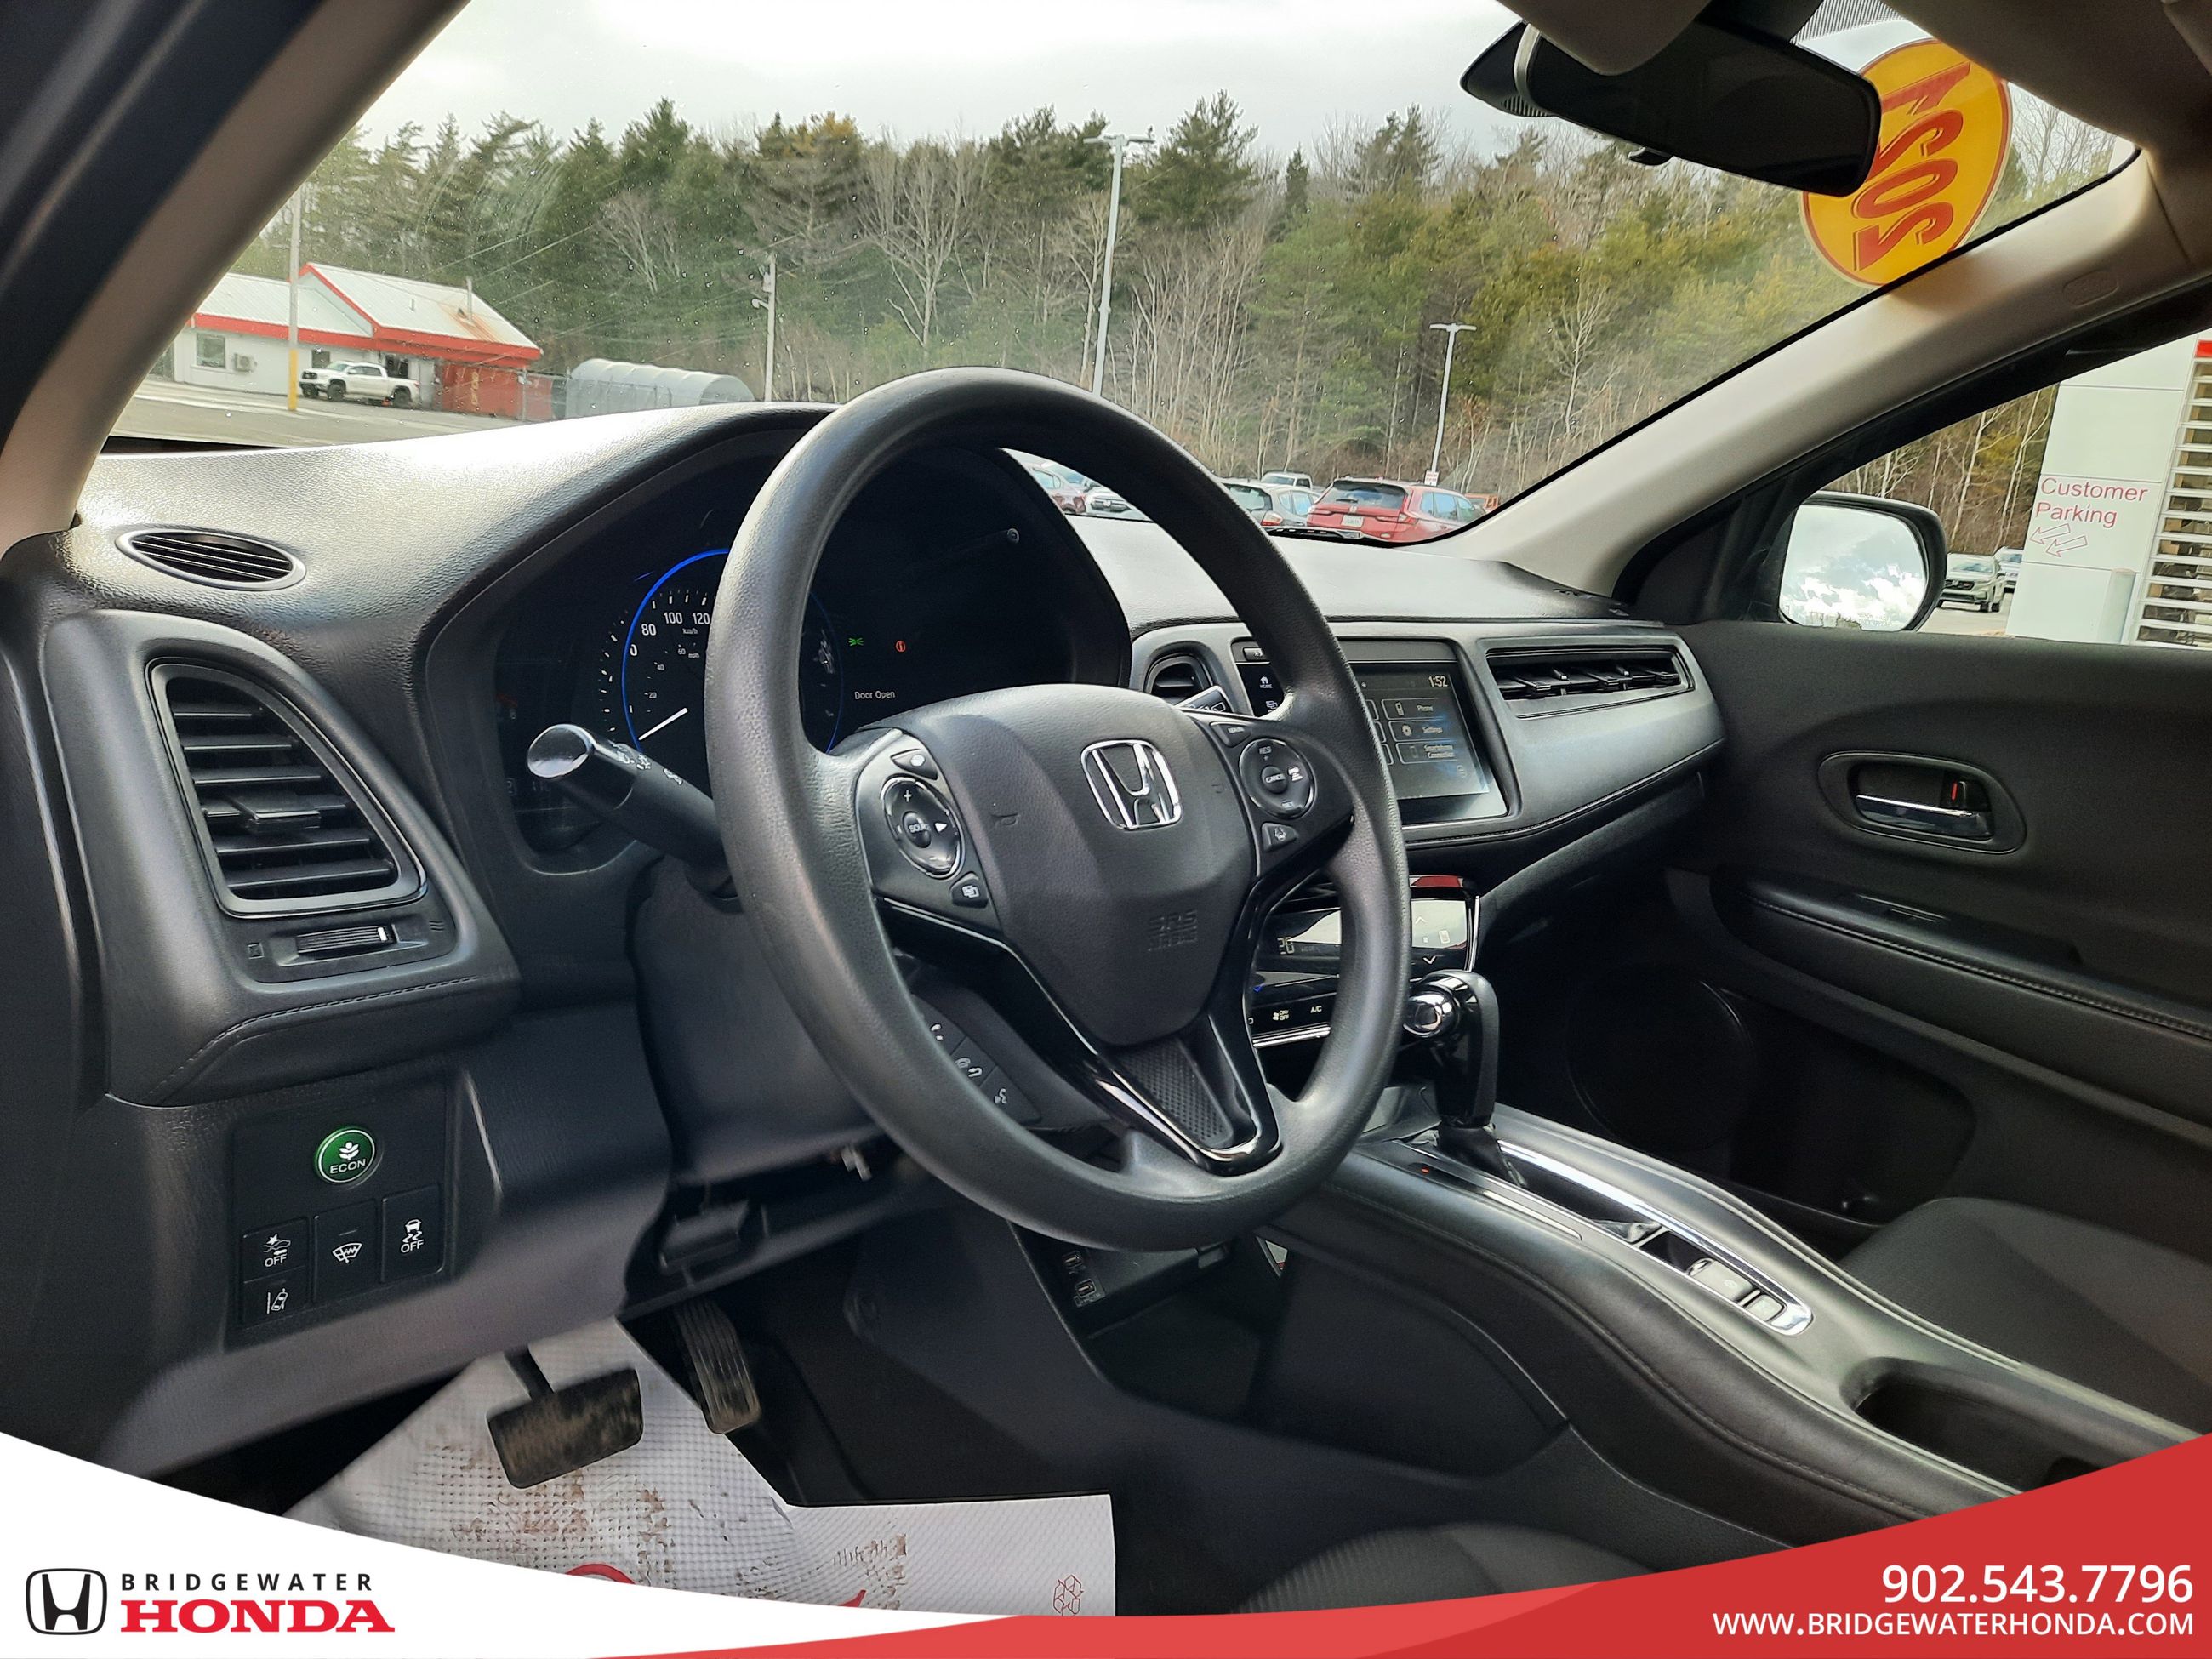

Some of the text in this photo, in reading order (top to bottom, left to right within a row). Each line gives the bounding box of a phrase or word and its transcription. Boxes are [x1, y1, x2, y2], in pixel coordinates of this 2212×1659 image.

[2041, 477, 2149, 502] Customer
[2035, 502, 2118, 528] Parking
[664, 612, 710, 624] 100 120
[641, 624, 657, 636] 80
[1428, 676, 1448, 687] 1:52
[854, 690, 896, 700] Door Open
[329, 1158, 366, 1175] ECON
[400, 1239, 425, 1253] OFF
[264, 1254, 288, 1268] OFF
